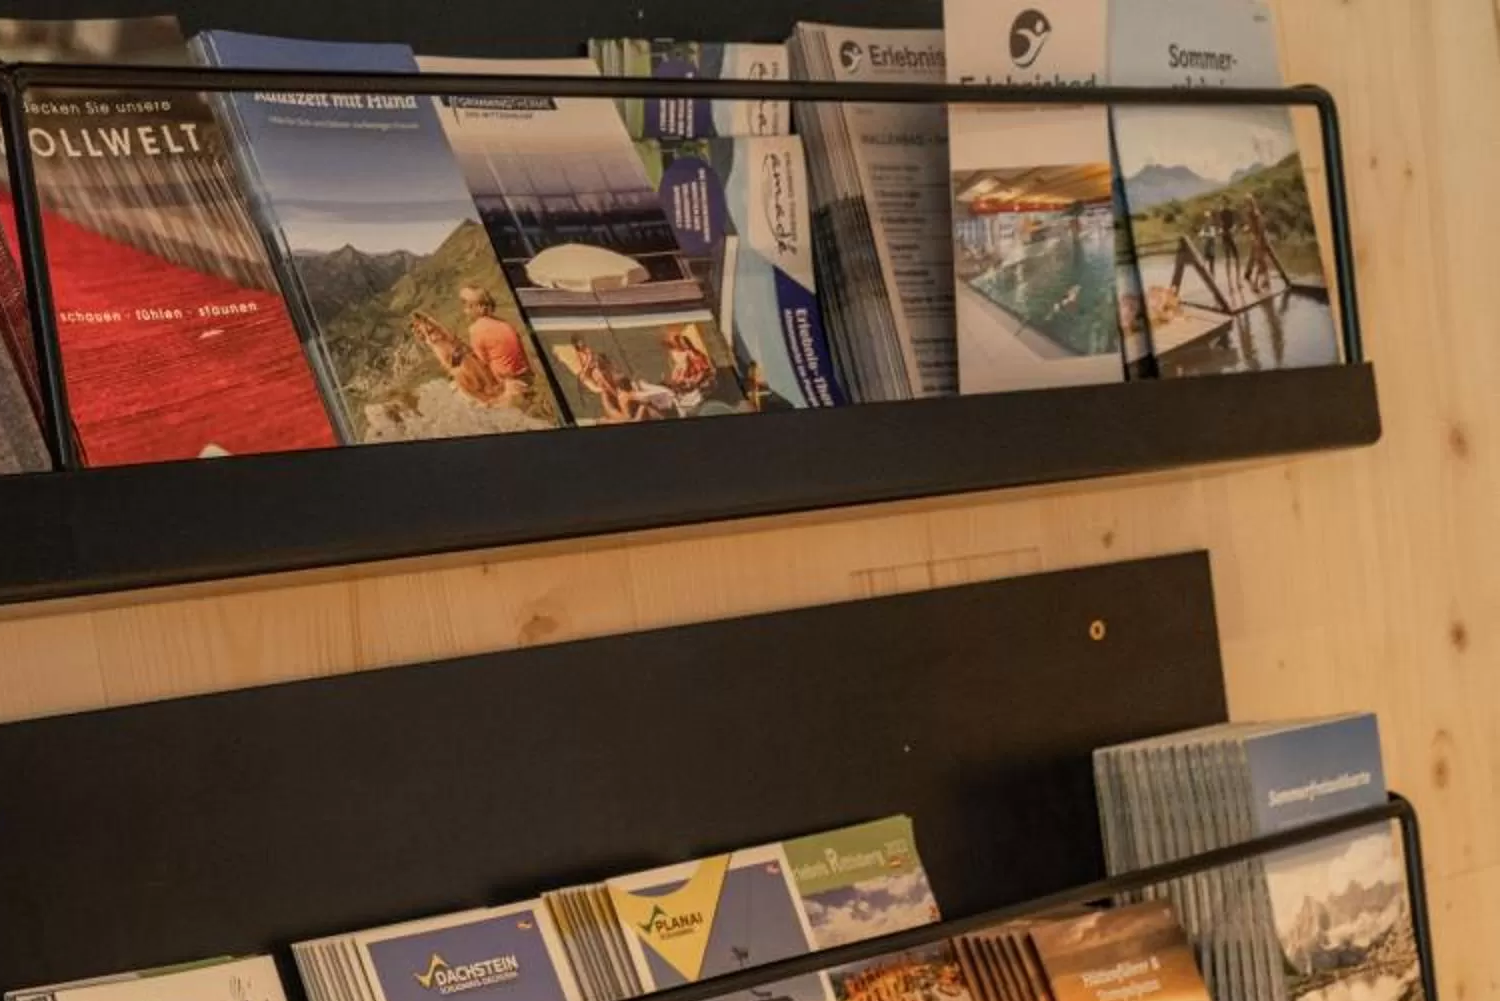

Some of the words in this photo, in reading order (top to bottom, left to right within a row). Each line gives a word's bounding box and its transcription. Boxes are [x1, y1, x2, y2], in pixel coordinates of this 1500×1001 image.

[1168, 43, 1238, 72] Sommer-
[85, 102, 110, 114] Sie
[116, 100, 172, 114] unsere
[59, 309, 122, 324] schauen
[198, 302, 258, 318] staunen
[655, 911, 704, 933] PLANAI
[434, 953, 520, 986] DACHSTEIN
